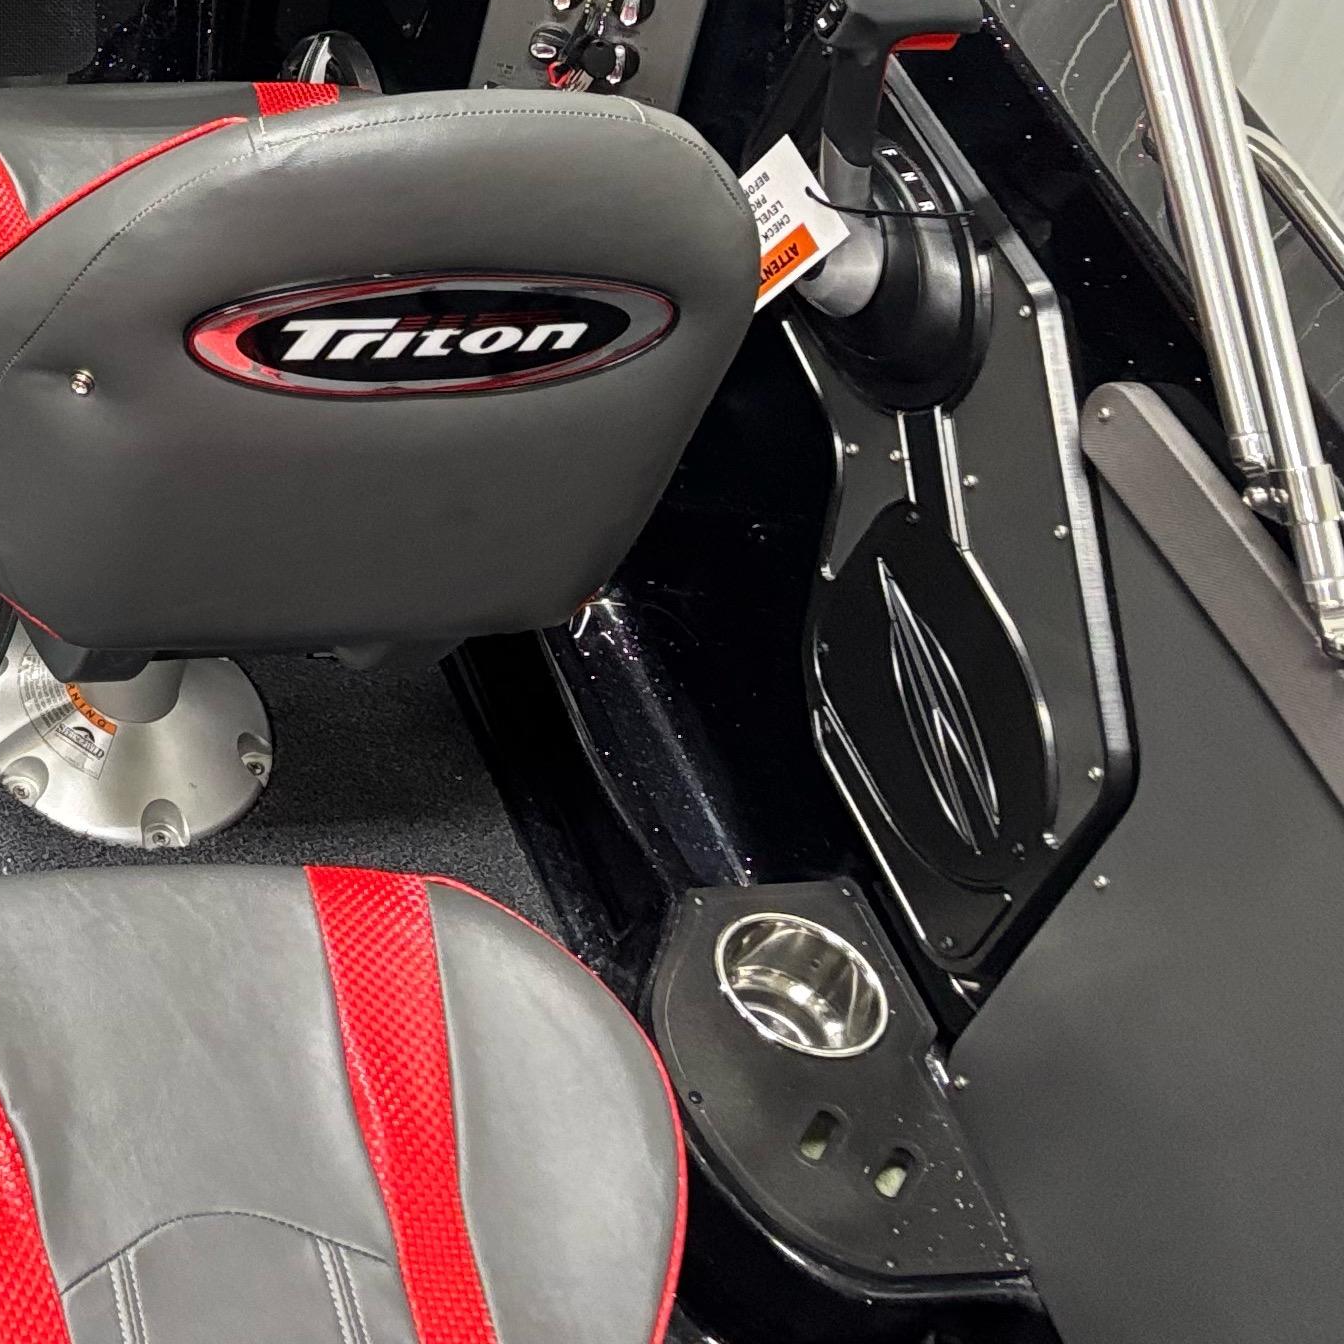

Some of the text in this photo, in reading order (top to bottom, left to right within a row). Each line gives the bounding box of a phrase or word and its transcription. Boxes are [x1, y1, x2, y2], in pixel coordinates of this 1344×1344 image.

[900, 171, 919, 182] N
[755, 200, 784, 225] LEVEL
[918, 200, 936, 212] R
[761, 214, 791, 243] CHECK
[279, 318, 589, 362] Triton
